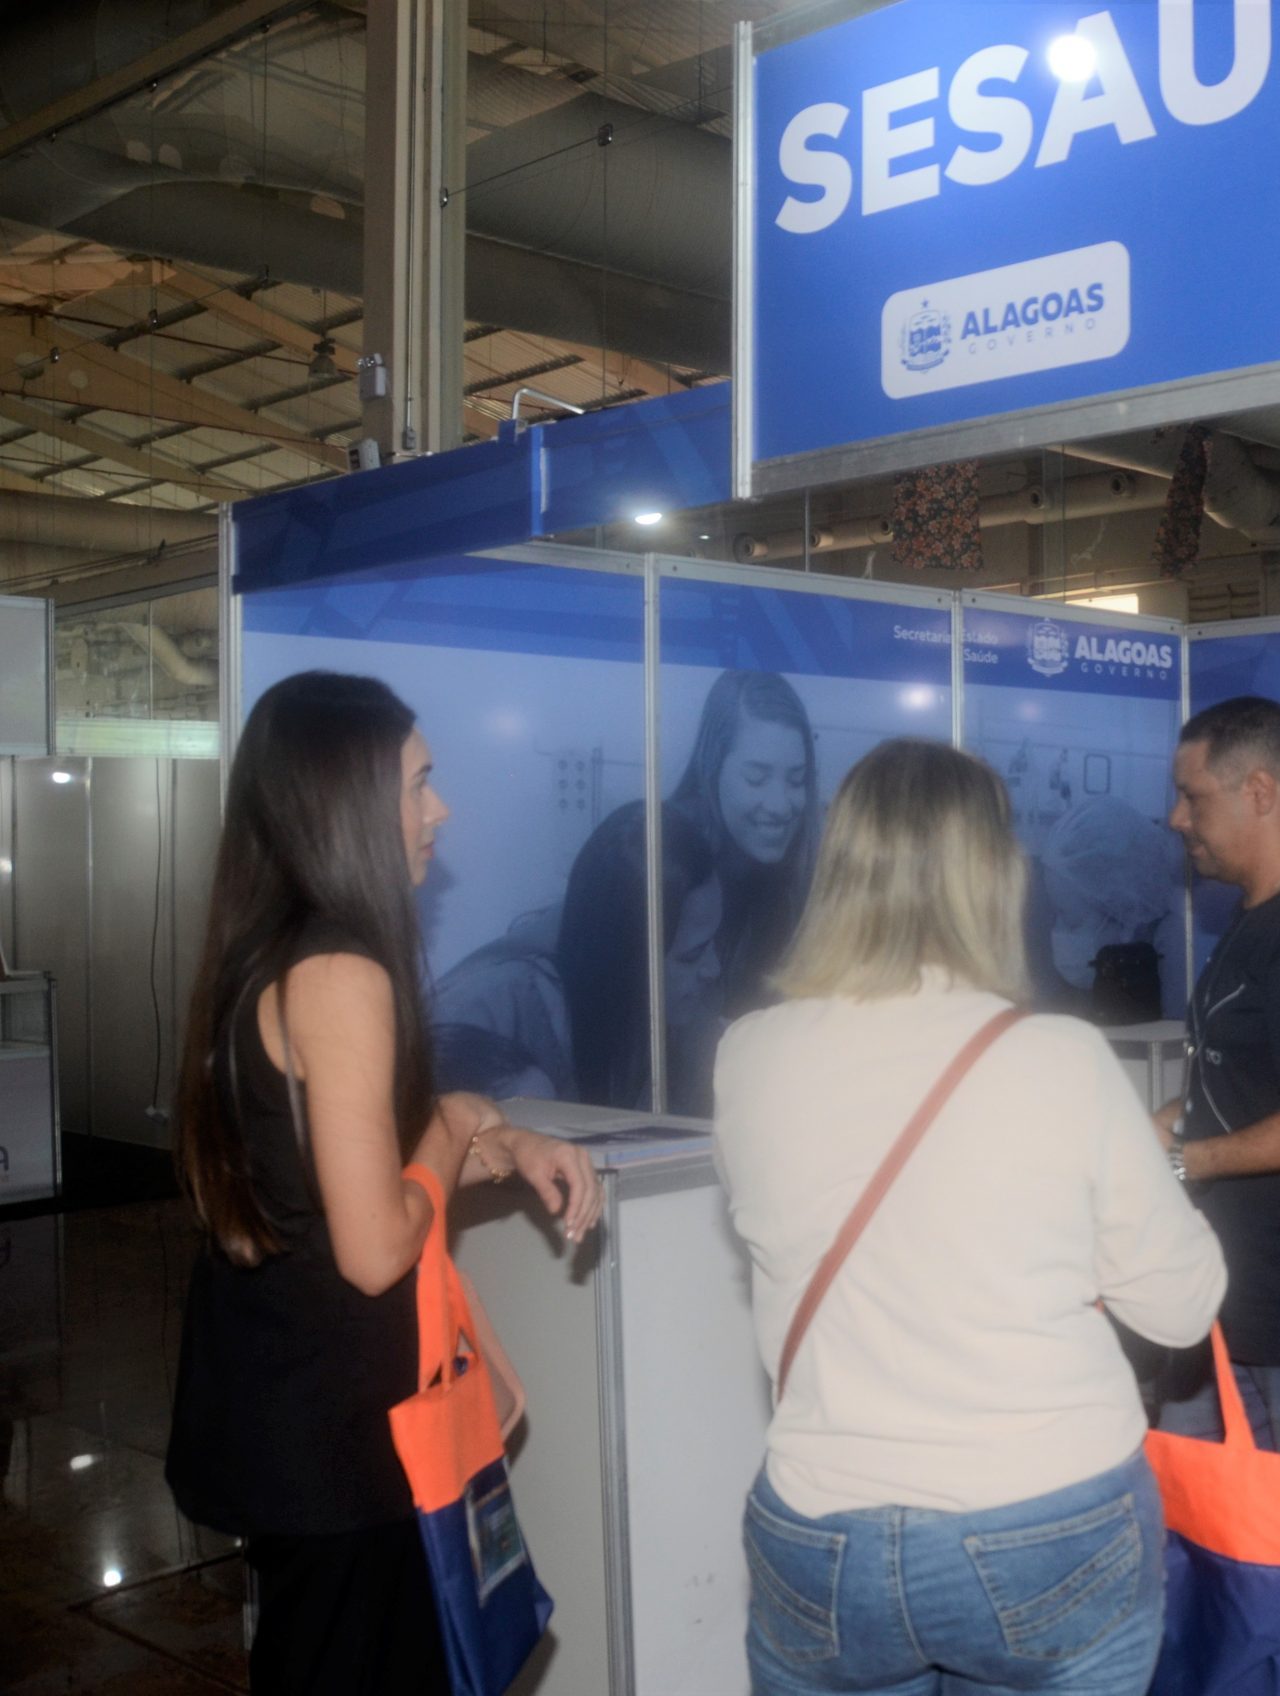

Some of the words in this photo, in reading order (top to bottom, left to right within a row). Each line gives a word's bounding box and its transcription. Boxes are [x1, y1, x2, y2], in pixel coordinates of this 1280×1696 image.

[775, 0, 1271, 234] SESAU
[960, 282, 1105, 341] ALAGOAS
[968, 317, 1097, 356] GOVERNO
[964, 648, 999, 664] Saúde
[1074, 635, 1172, 669] ALAGOAS
[1080, 662, 1168, 680] GOVERNO
